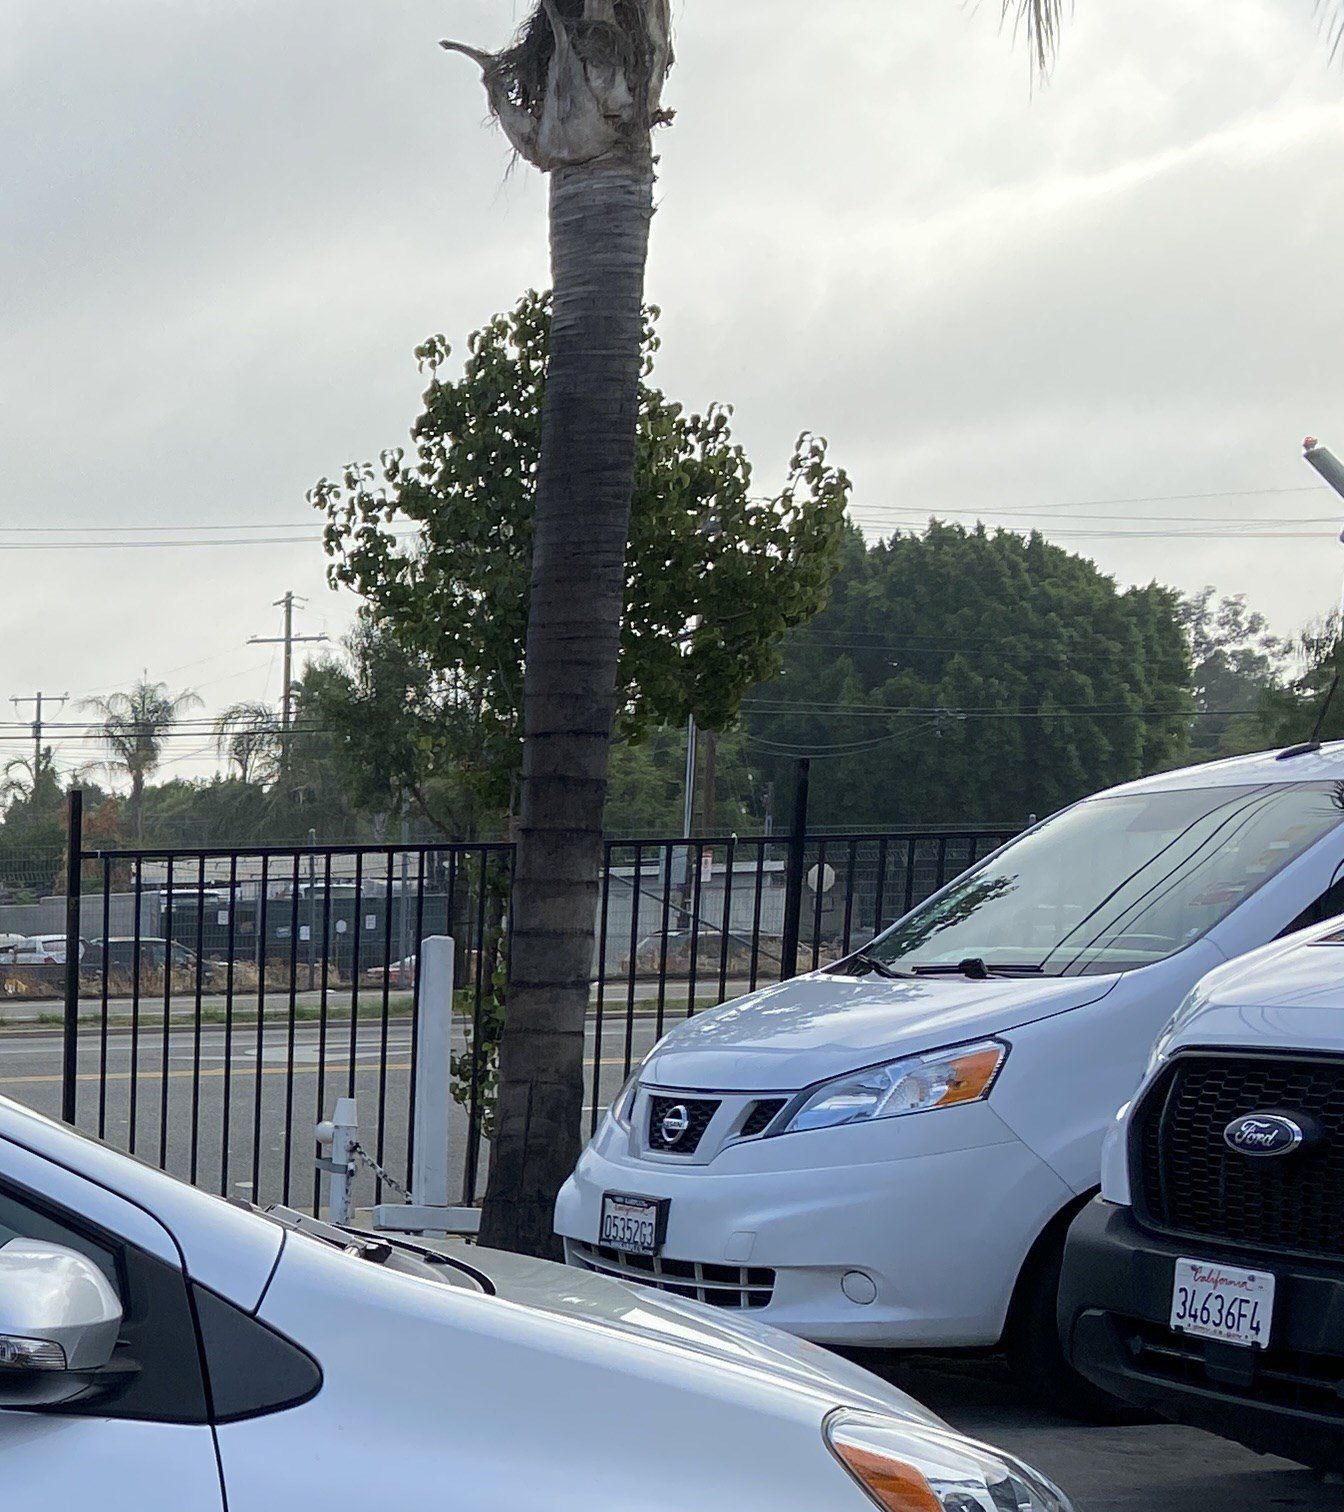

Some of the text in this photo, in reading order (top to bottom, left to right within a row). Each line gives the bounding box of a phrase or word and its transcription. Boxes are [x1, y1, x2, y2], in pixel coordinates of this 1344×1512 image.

[1234, 1120, 1279, 1147] Ford
[604, 1214, 654, 1246] 05352G3
[1192, 1265, 1254, 1291] California
[1176, 1286, 1261, 1336] 34636F4
